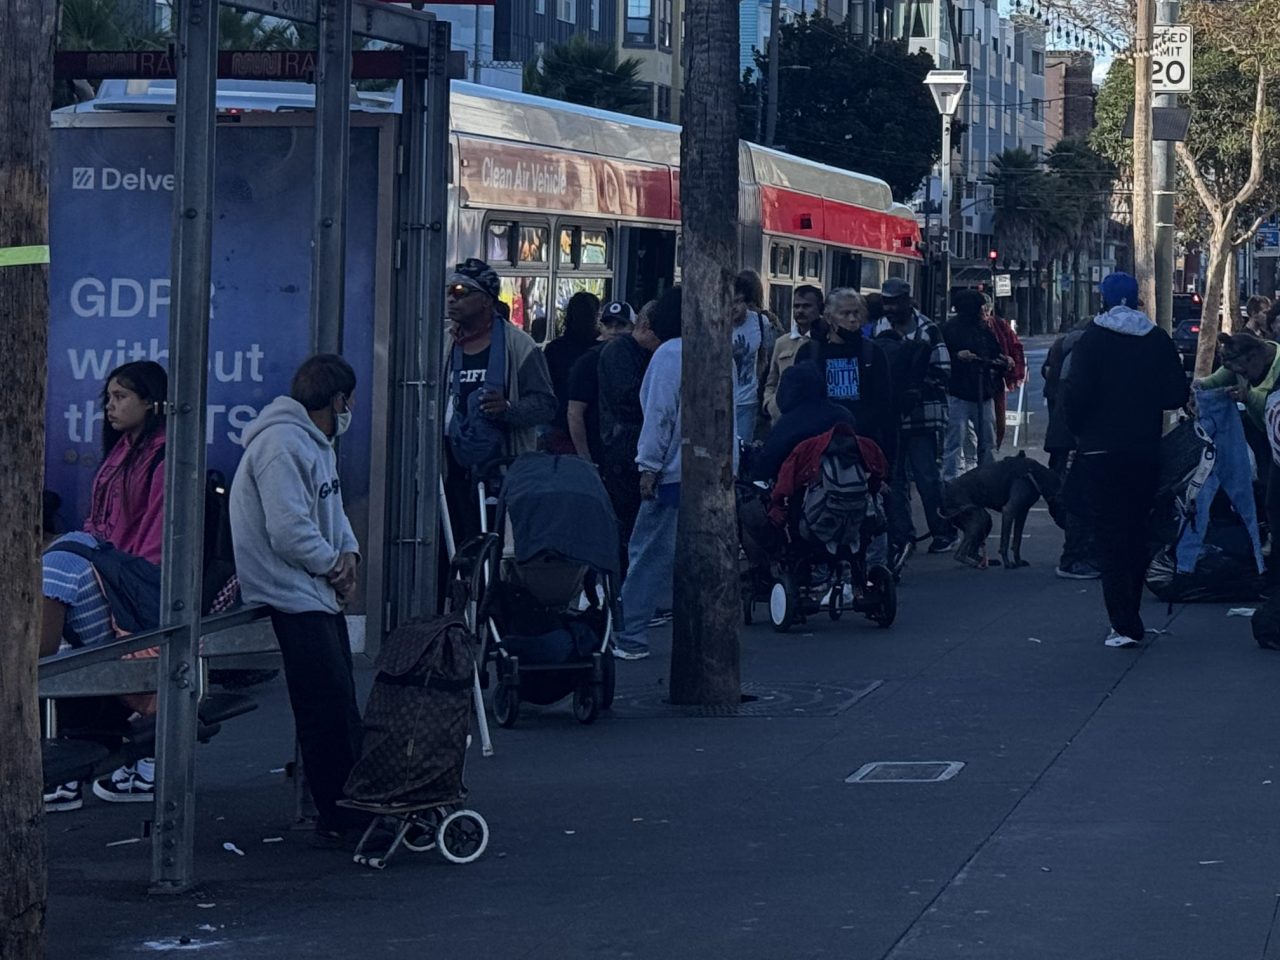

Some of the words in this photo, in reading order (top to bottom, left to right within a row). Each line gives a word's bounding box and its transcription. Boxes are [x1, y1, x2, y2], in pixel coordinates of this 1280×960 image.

[1153, 33, 1187, 43] PEED
[1160, 46, 1182, 57] MIT
[1152, 60, 1185, 84] 20
[102, 168, 174, 191] Delve
[482, 157, 513, 188] Clean
[514, 162, 529, 191] Air
[531, 164, 567, 195] Vehicle
[70, 278, 215, 317] GDP
[67, 339, 264, 382] withut
[827, 369, 858, 386] OUTTA
